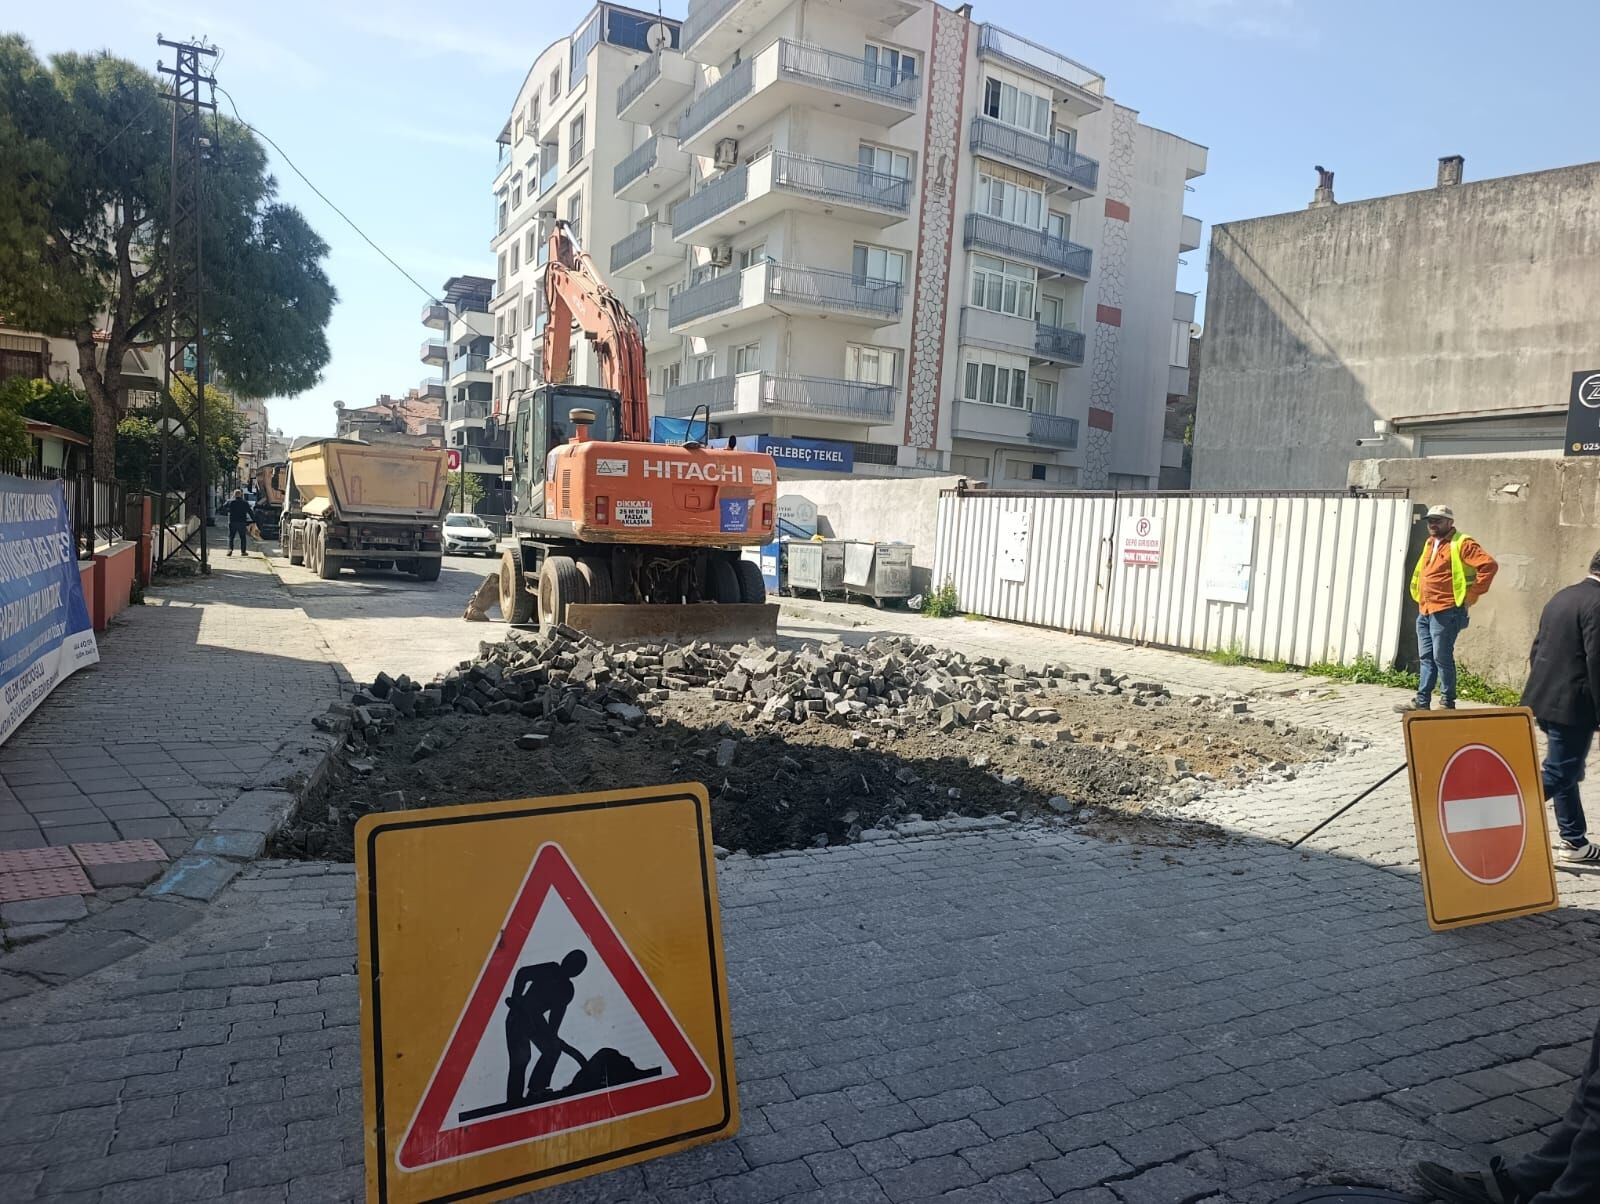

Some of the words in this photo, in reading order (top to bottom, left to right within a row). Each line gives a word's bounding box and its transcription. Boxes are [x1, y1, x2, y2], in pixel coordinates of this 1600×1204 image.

[765, 445, 812, 462] GELEBEÇ
[814, 449, 844, 463] TEKEL
[643, 459, 743, 483] HITACHI
